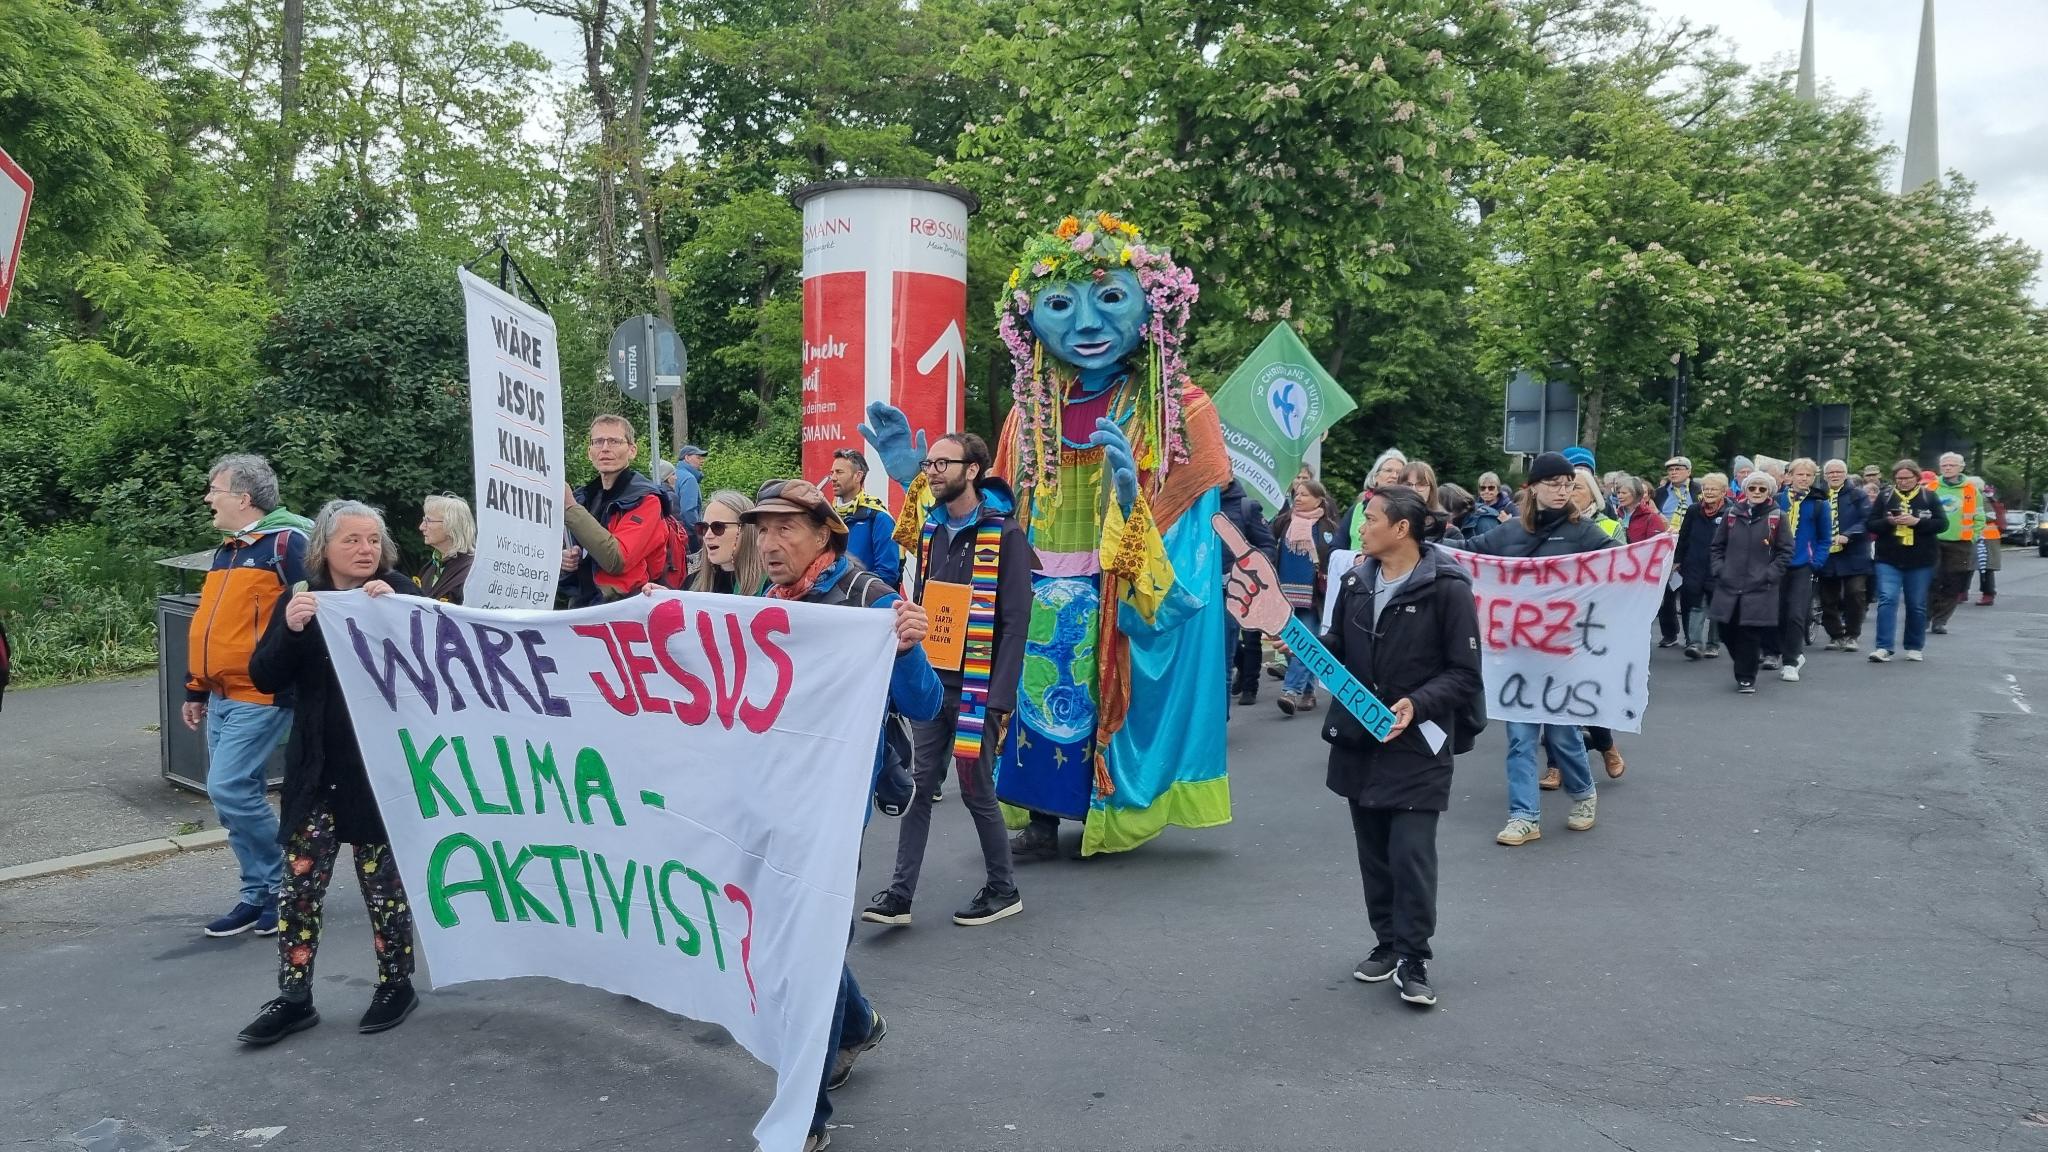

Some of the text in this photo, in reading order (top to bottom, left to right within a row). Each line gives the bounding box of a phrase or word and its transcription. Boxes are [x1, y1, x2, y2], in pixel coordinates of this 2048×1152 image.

[491, 315, 542, 369] WÄRE
[810, 335, 848, 360] mehr
[628, 344, 638, 390] VESTRA
[498, 371, 545, 425] JESUS
[806, 402, 837, 415] deinem
[1306, 383, 1320, 422] FUTURE
[486, 477, 552, 529] AKTIVIST
[512, 541, 530, 557] sind
[493, 560, 516, 576] erste
[488, 579, 503, 596] die
[505, 583, 519, 599] die
[934, 615, 953, 625] EARTH
[940, 605, 950, 614] ON
[1474, 594, 1608, 656] ERZt
[929, 634, 952, 644] HEAVEN
[934, 625, 950, 634] AS IN
[345, 598, 795, 734] WÄRE JESUS
[1285, 626, 1392, 736] MUTTER ERDE
[426, 832, 758, 1015] AKTIVIST?
